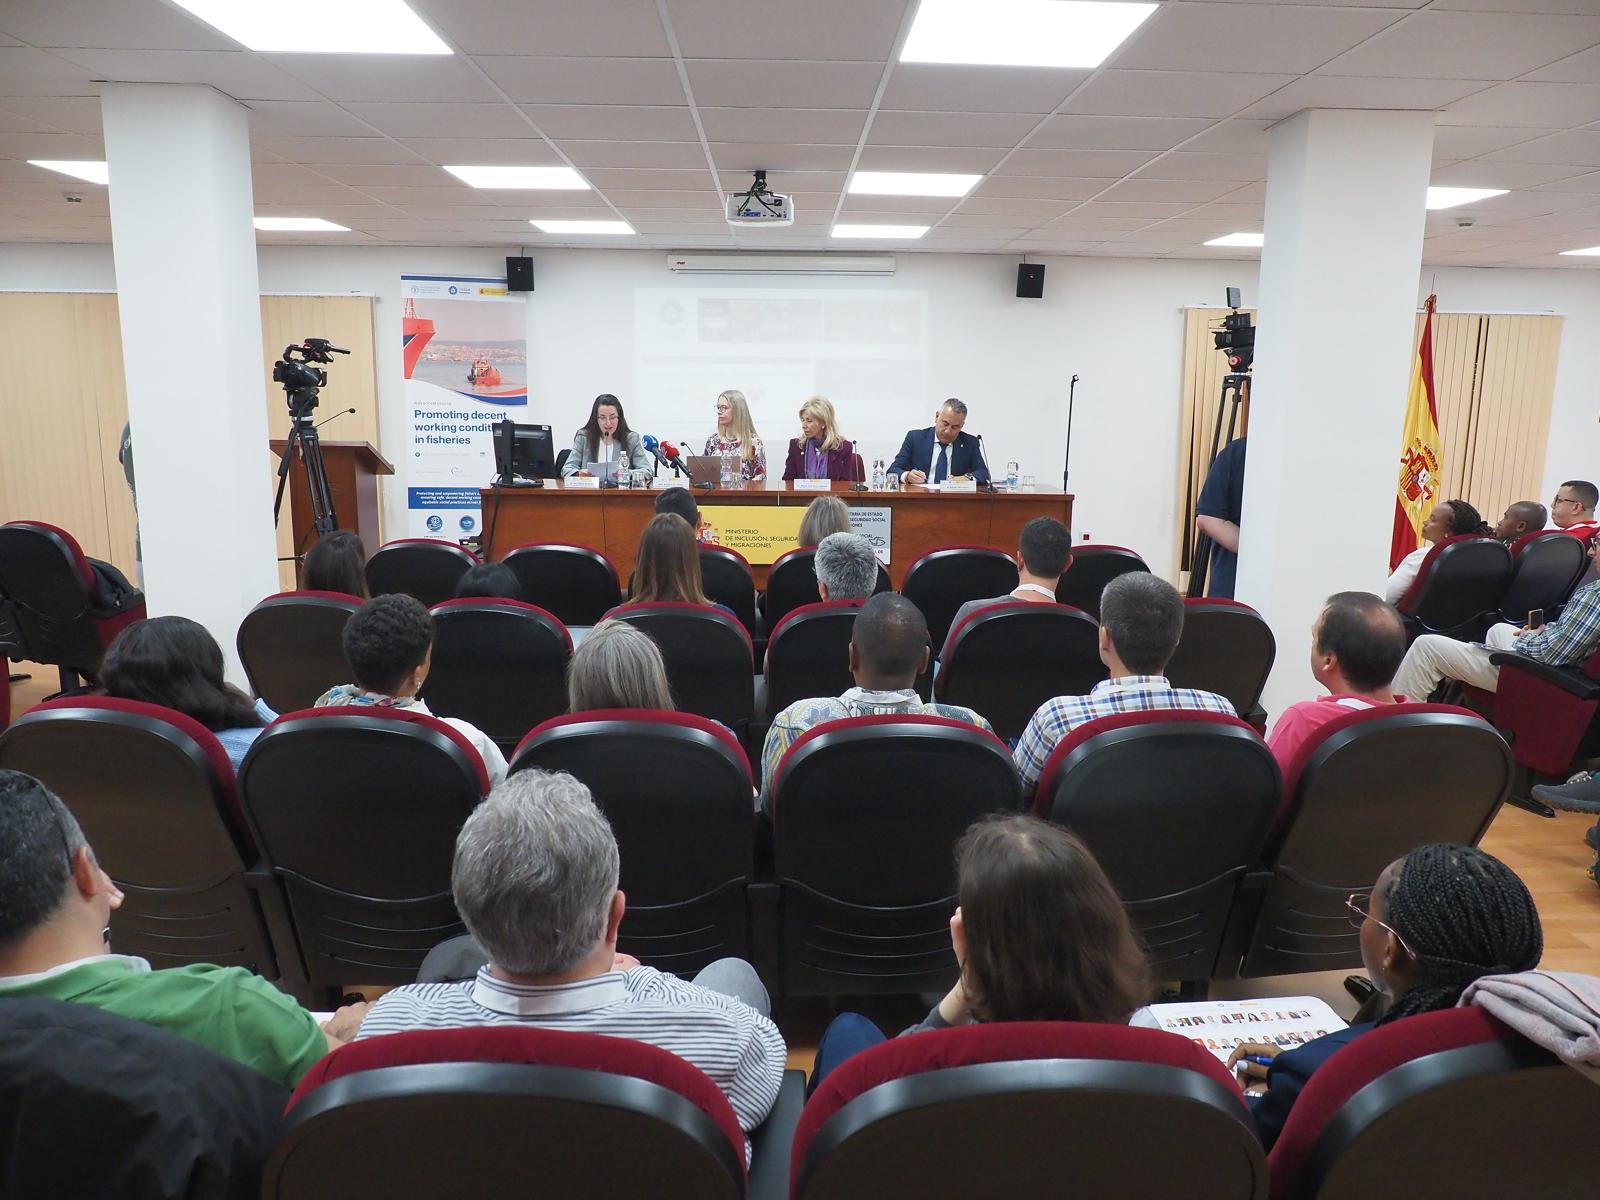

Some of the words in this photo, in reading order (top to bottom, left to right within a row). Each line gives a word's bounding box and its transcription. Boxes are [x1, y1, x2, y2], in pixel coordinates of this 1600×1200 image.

[414, 410, 469, 421] Promoting
[471, 411, 507, 419] decent
[415, 423, 457, 433] working
[459, 423, 491, 432] condit
[415, 435, 425, 444] in
[426, 435, 470, 444] fisheries
